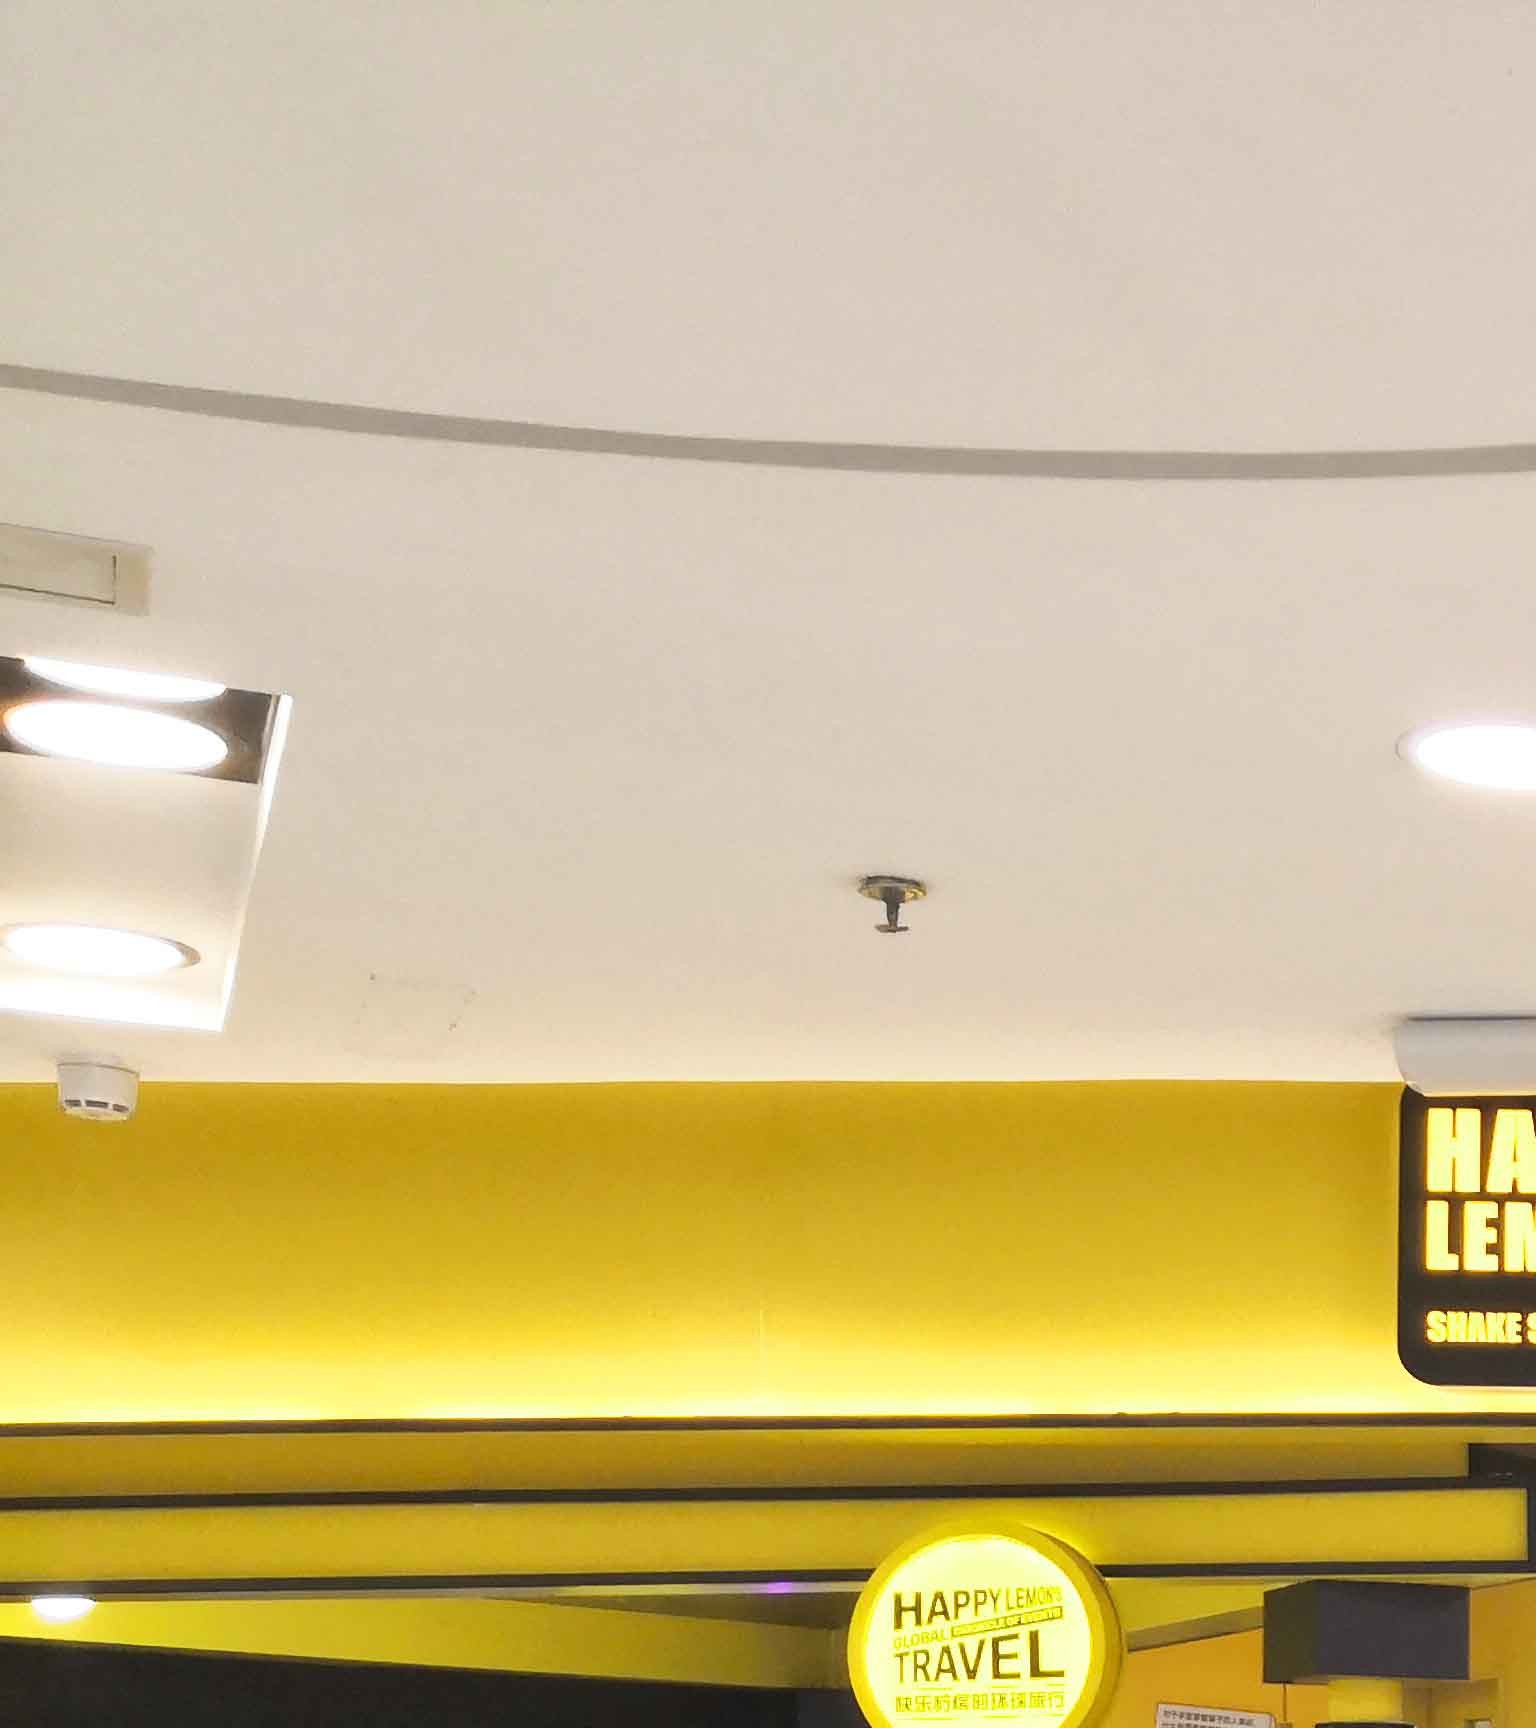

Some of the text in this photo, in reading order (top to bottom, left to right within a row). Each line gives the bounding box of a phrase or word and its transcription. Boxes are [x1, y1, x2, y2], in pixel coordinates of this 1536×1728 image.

[1426, 1311, 1522, 1344] SHAKE
[893, 1588, 1003, 1631] HAPPY
[893, 1629, 1065, 1684] TRAVEL
